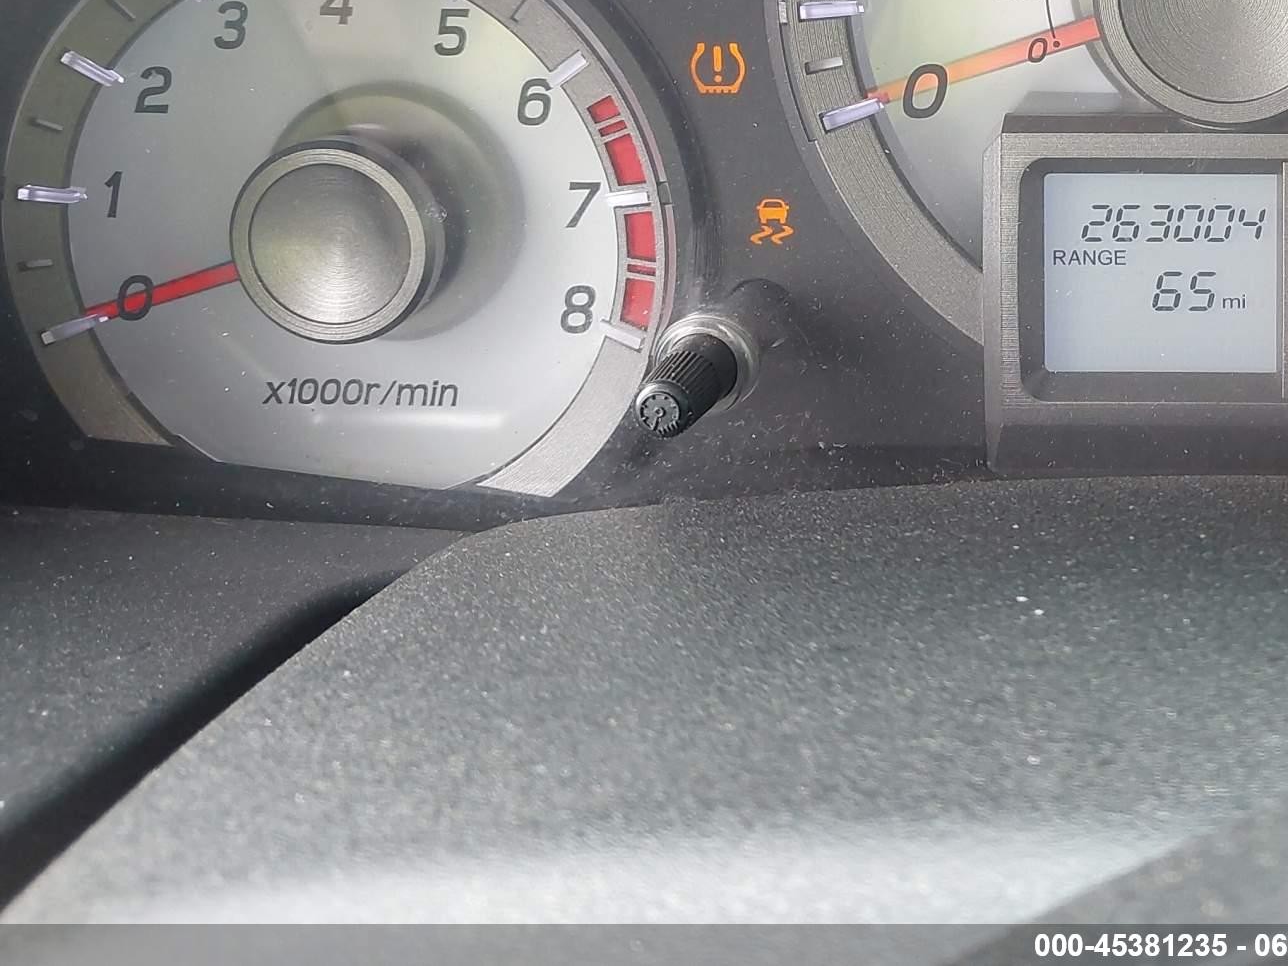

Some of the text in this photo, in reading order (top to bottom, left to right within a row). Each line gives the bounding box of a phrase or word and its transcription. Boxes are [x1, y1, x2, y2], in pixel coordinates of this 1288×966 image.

[214, 1, 248, 50] 3
[434, 9, 470, 56] 5
[1028, 37, 1048, 63] 0
[135, 66, 172, 114] 2
[517, 79, 552, 126] 6
[903, 64, 948, 119] 0
[104, 171, 123, 218] 1
[564, 182, 601, 228] 7
[1081, 204, 1266, 242] 263004
[1052, 250, 1127, 266] RANGE
[117, 275, 153, 321] 0
[560, 285, 596, 333] 8
[1151, 271, 1247, 312] 65 mi
[263, 378, 459, 407] x1000r/min
